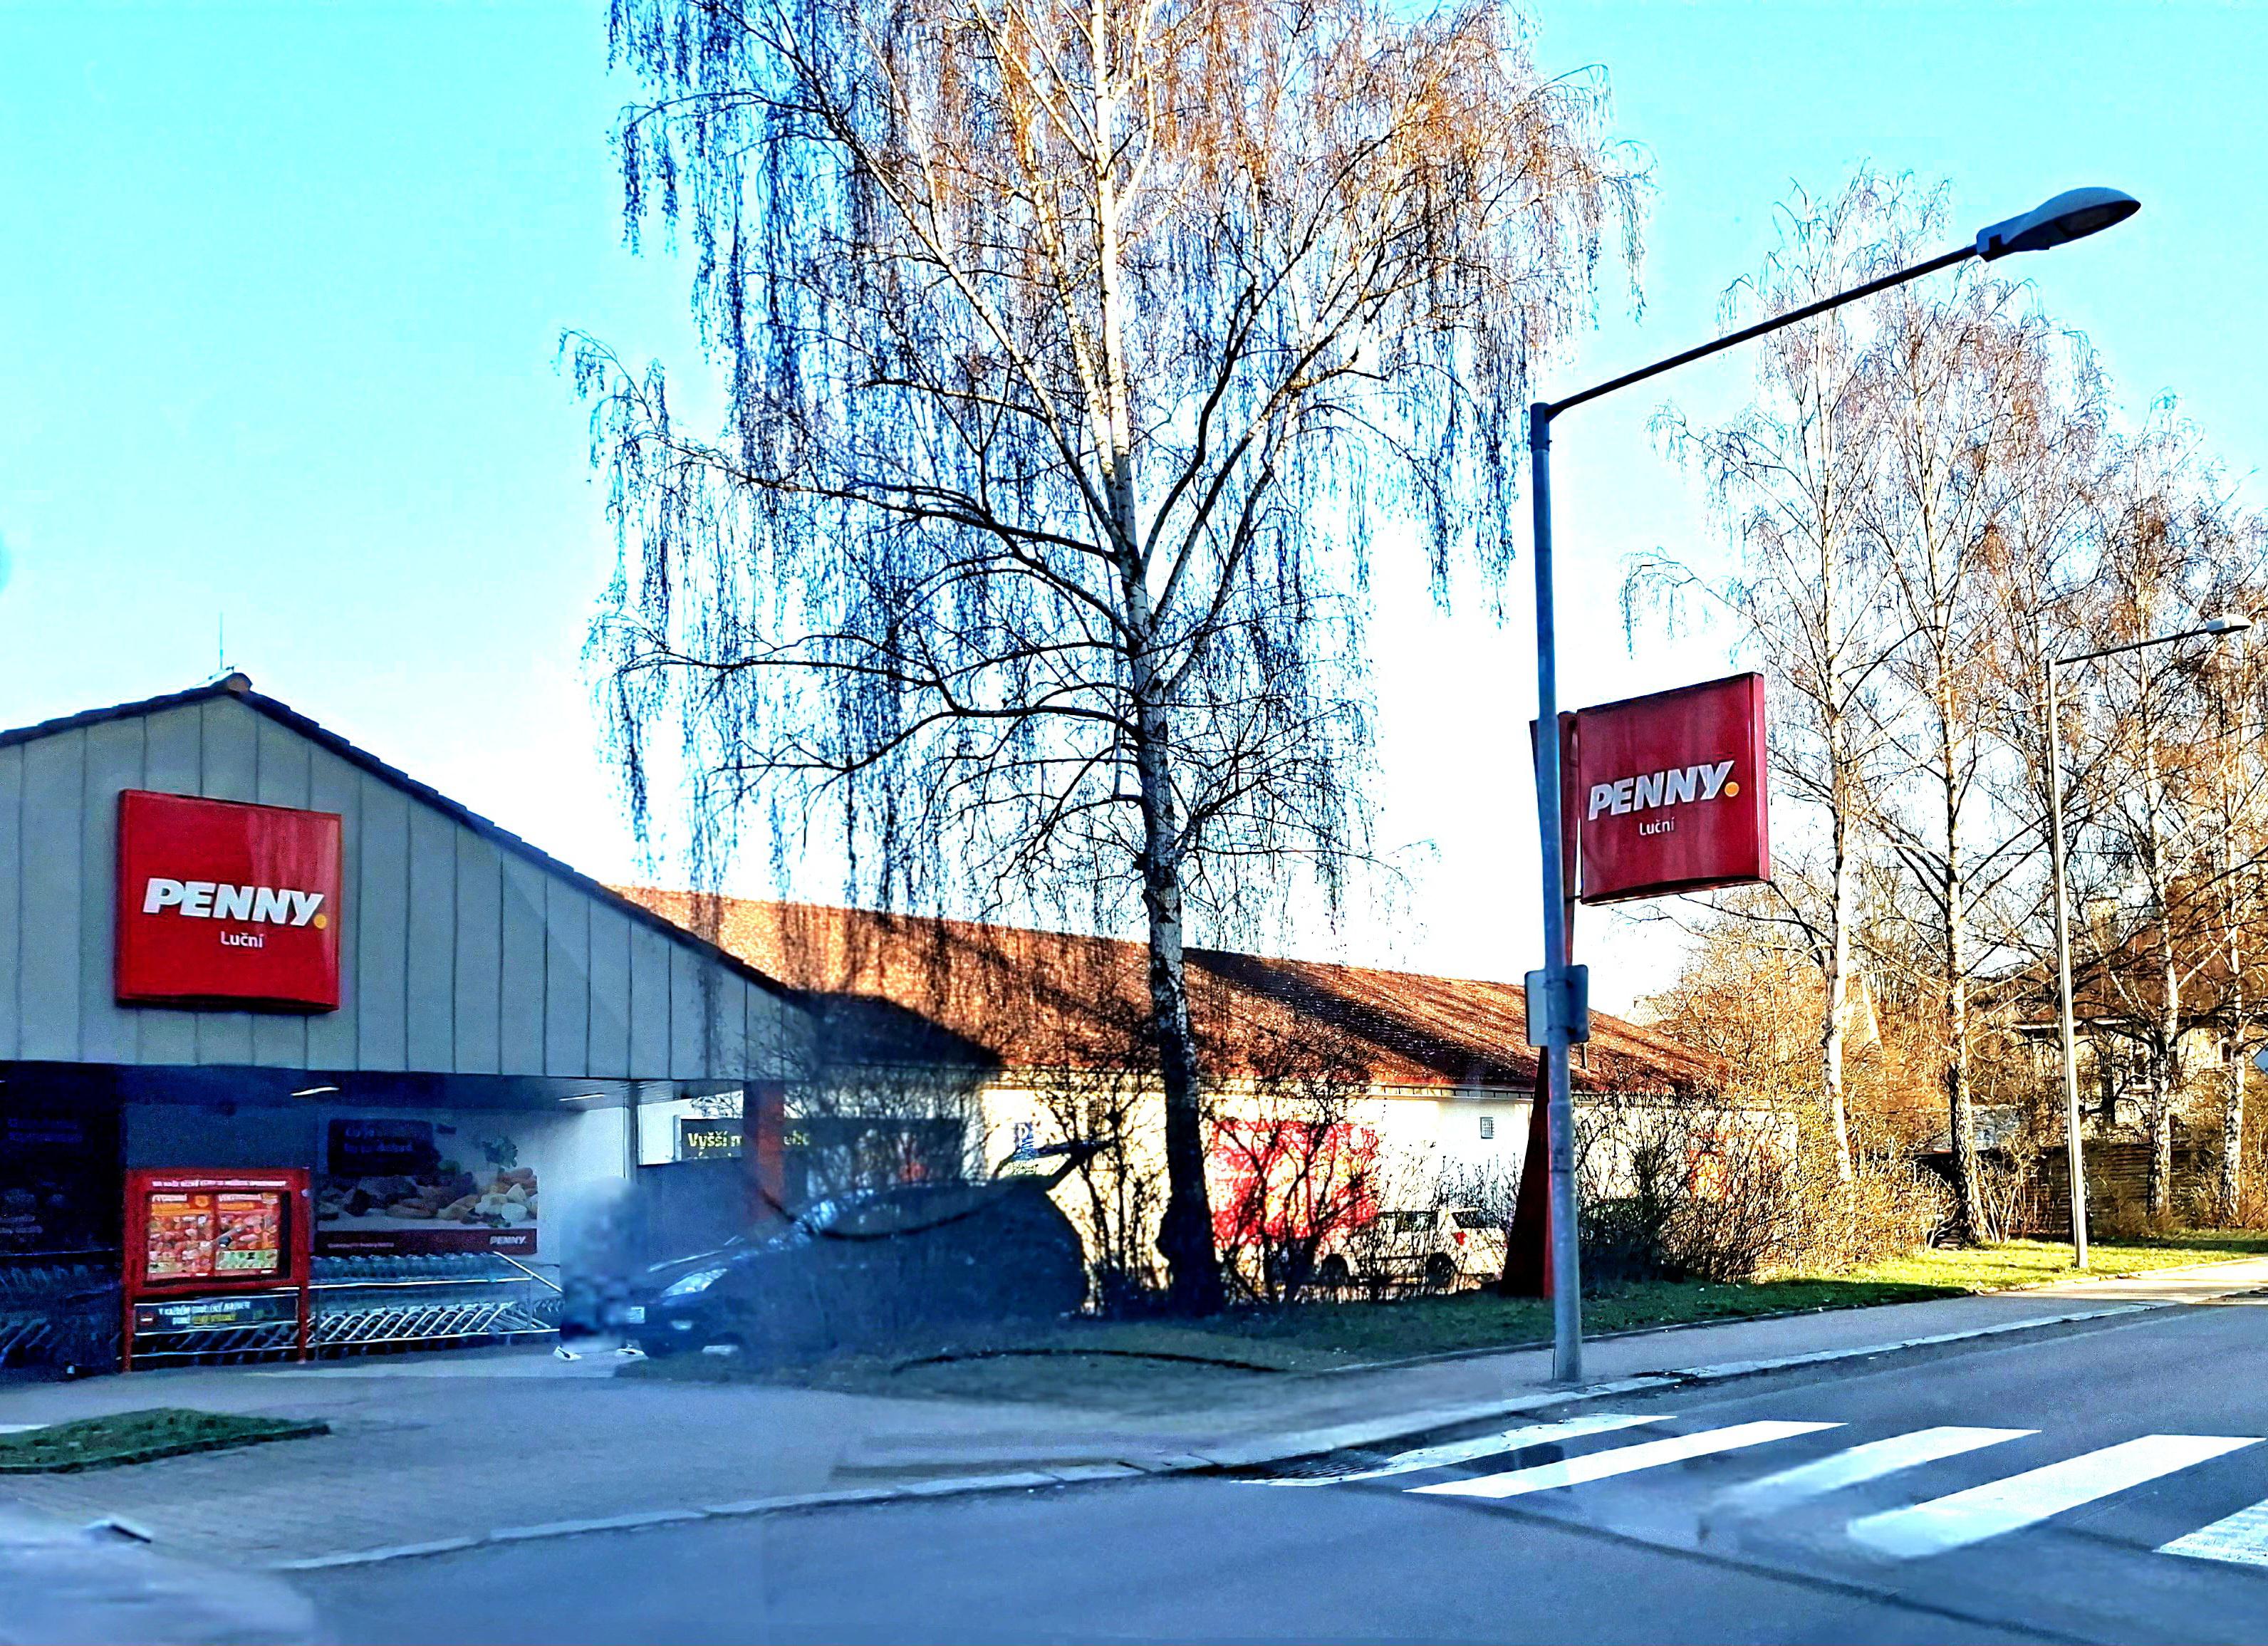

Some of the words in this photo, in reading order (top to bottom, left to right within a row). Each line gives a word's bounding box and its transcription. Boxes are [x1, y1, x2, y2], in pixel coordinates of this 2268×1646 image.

[1639, 817, 1675, 835] Luční
[220, 931, 264, 948] Luční
[687, 1130, 728, 1149] Vyšší
